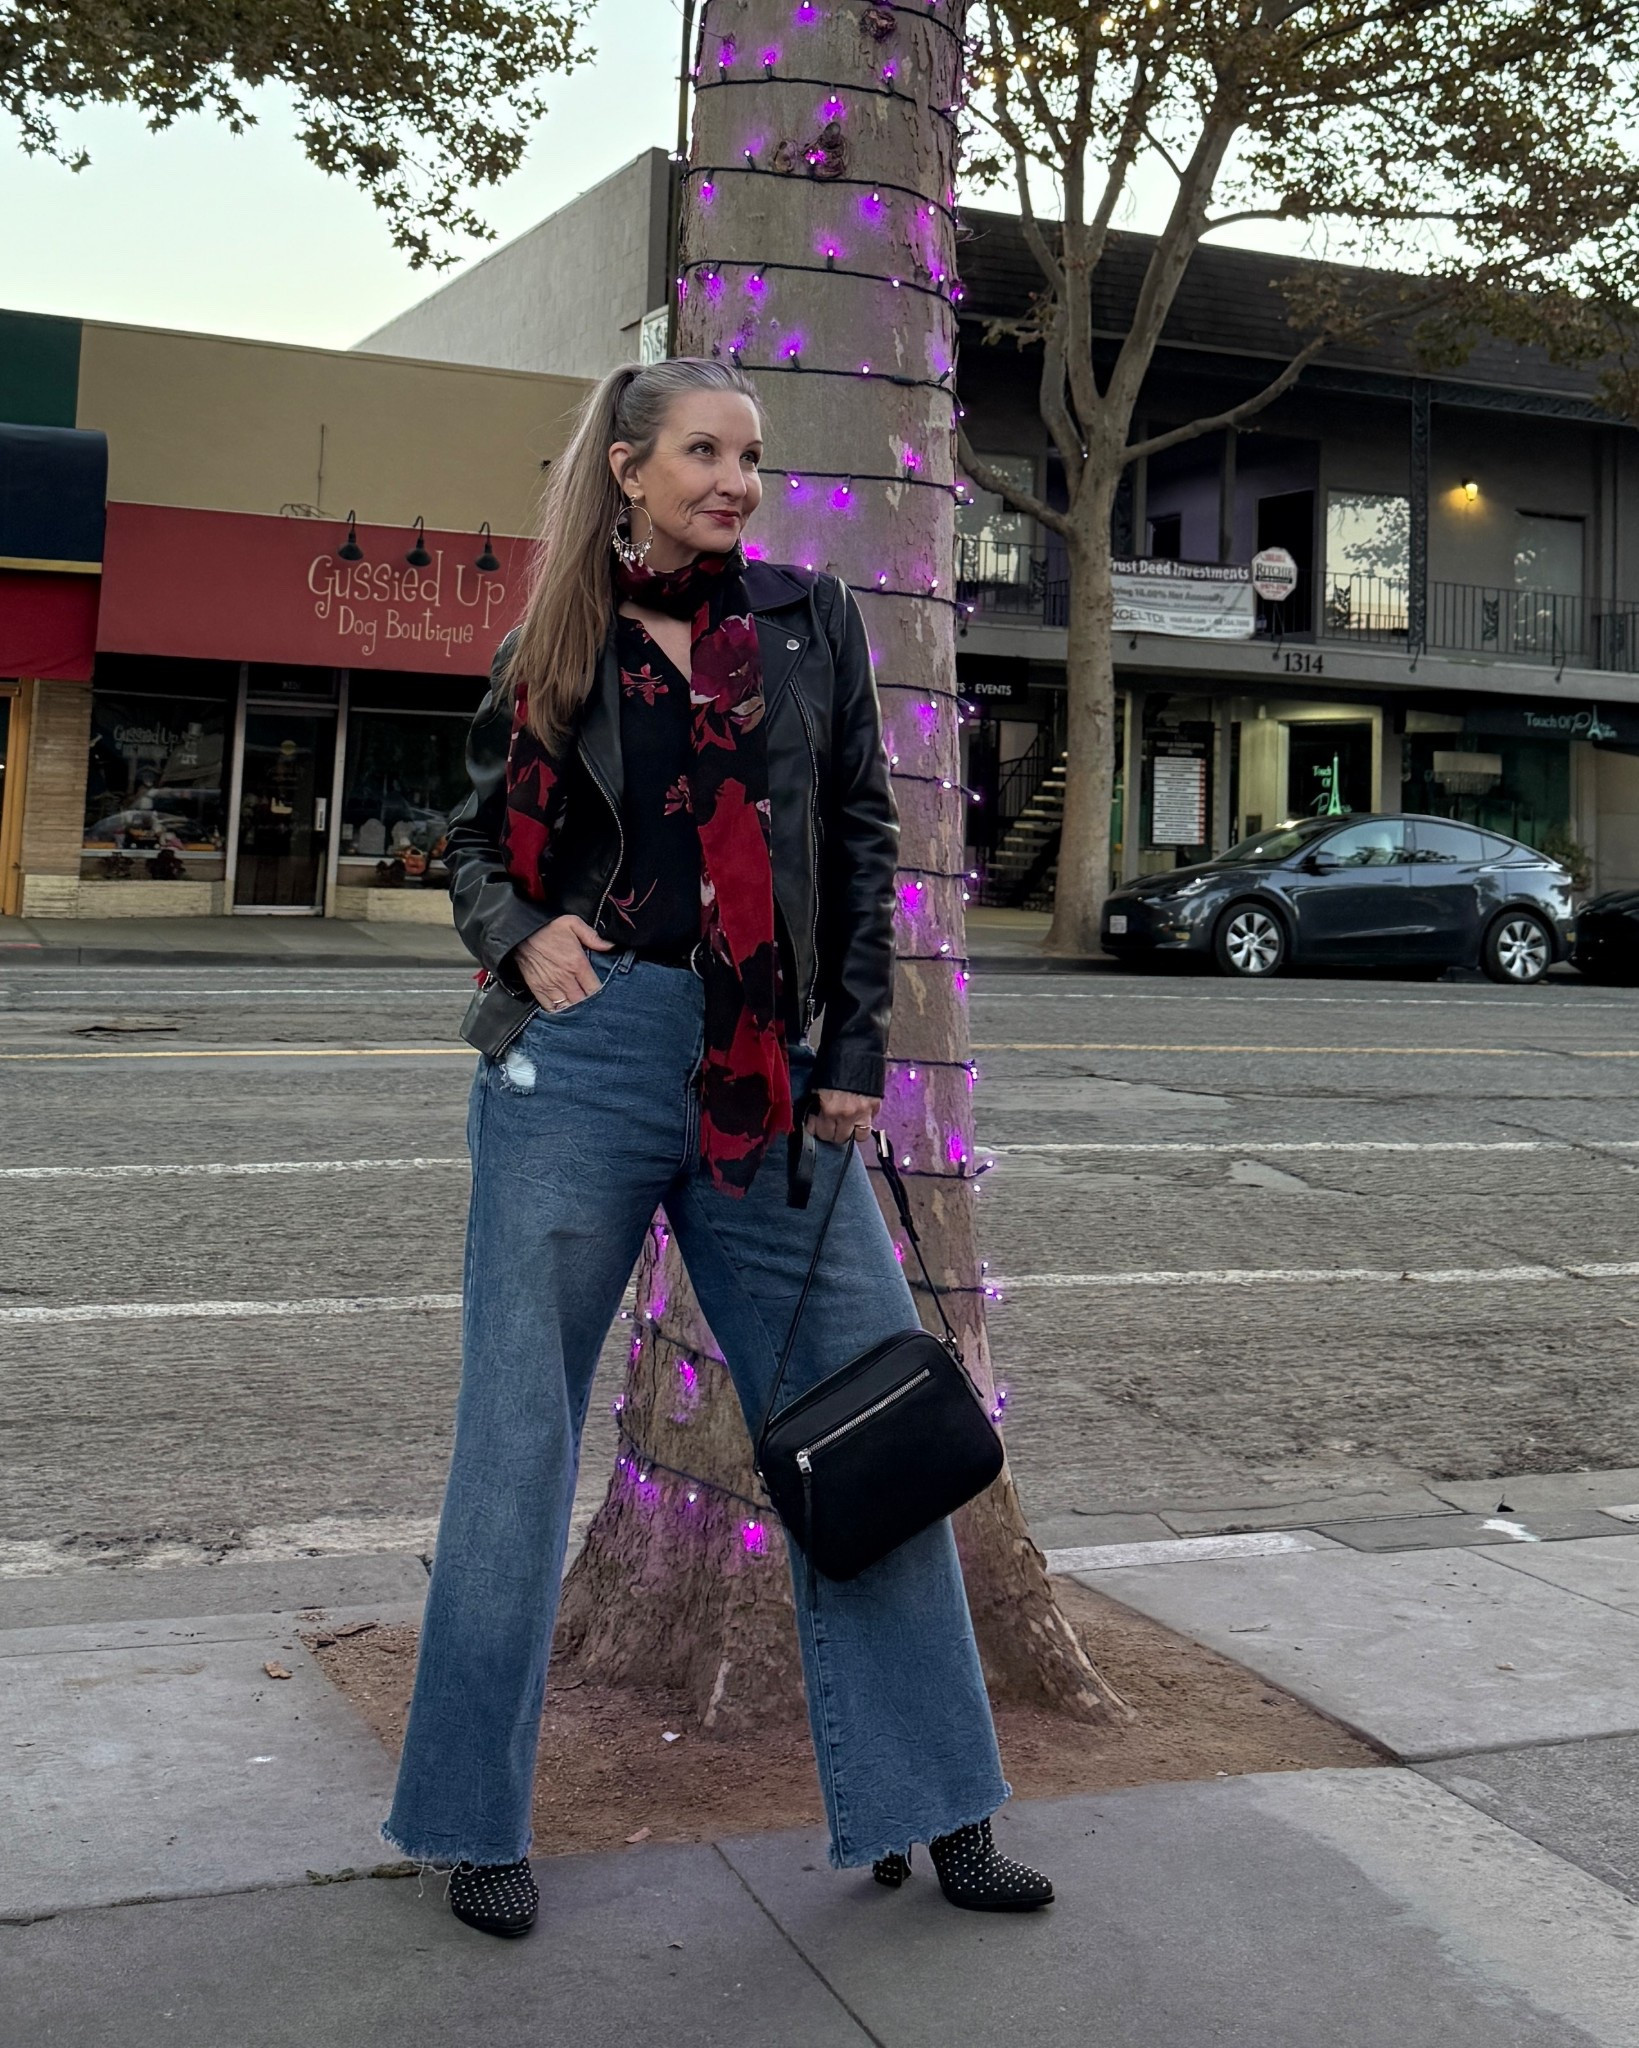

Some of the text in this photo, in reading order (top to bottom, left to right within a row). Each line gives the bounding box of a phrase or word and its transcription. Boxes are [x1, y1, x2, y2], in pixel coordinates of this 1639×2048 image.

[1139, 559, 1171, 576] Deed
[1173, 561, 1249, 580] Investments
[307, 550, 505, 629] Gussied Up
[338, 605, 473, 657] Dog Boutique
[1283, 653, 1324, 674] 1314
[975, 683, 1012, 696] EVENTS
[1523, 711, 1557, 728] Touch
[1312, 765, 1332, 776] Touch
